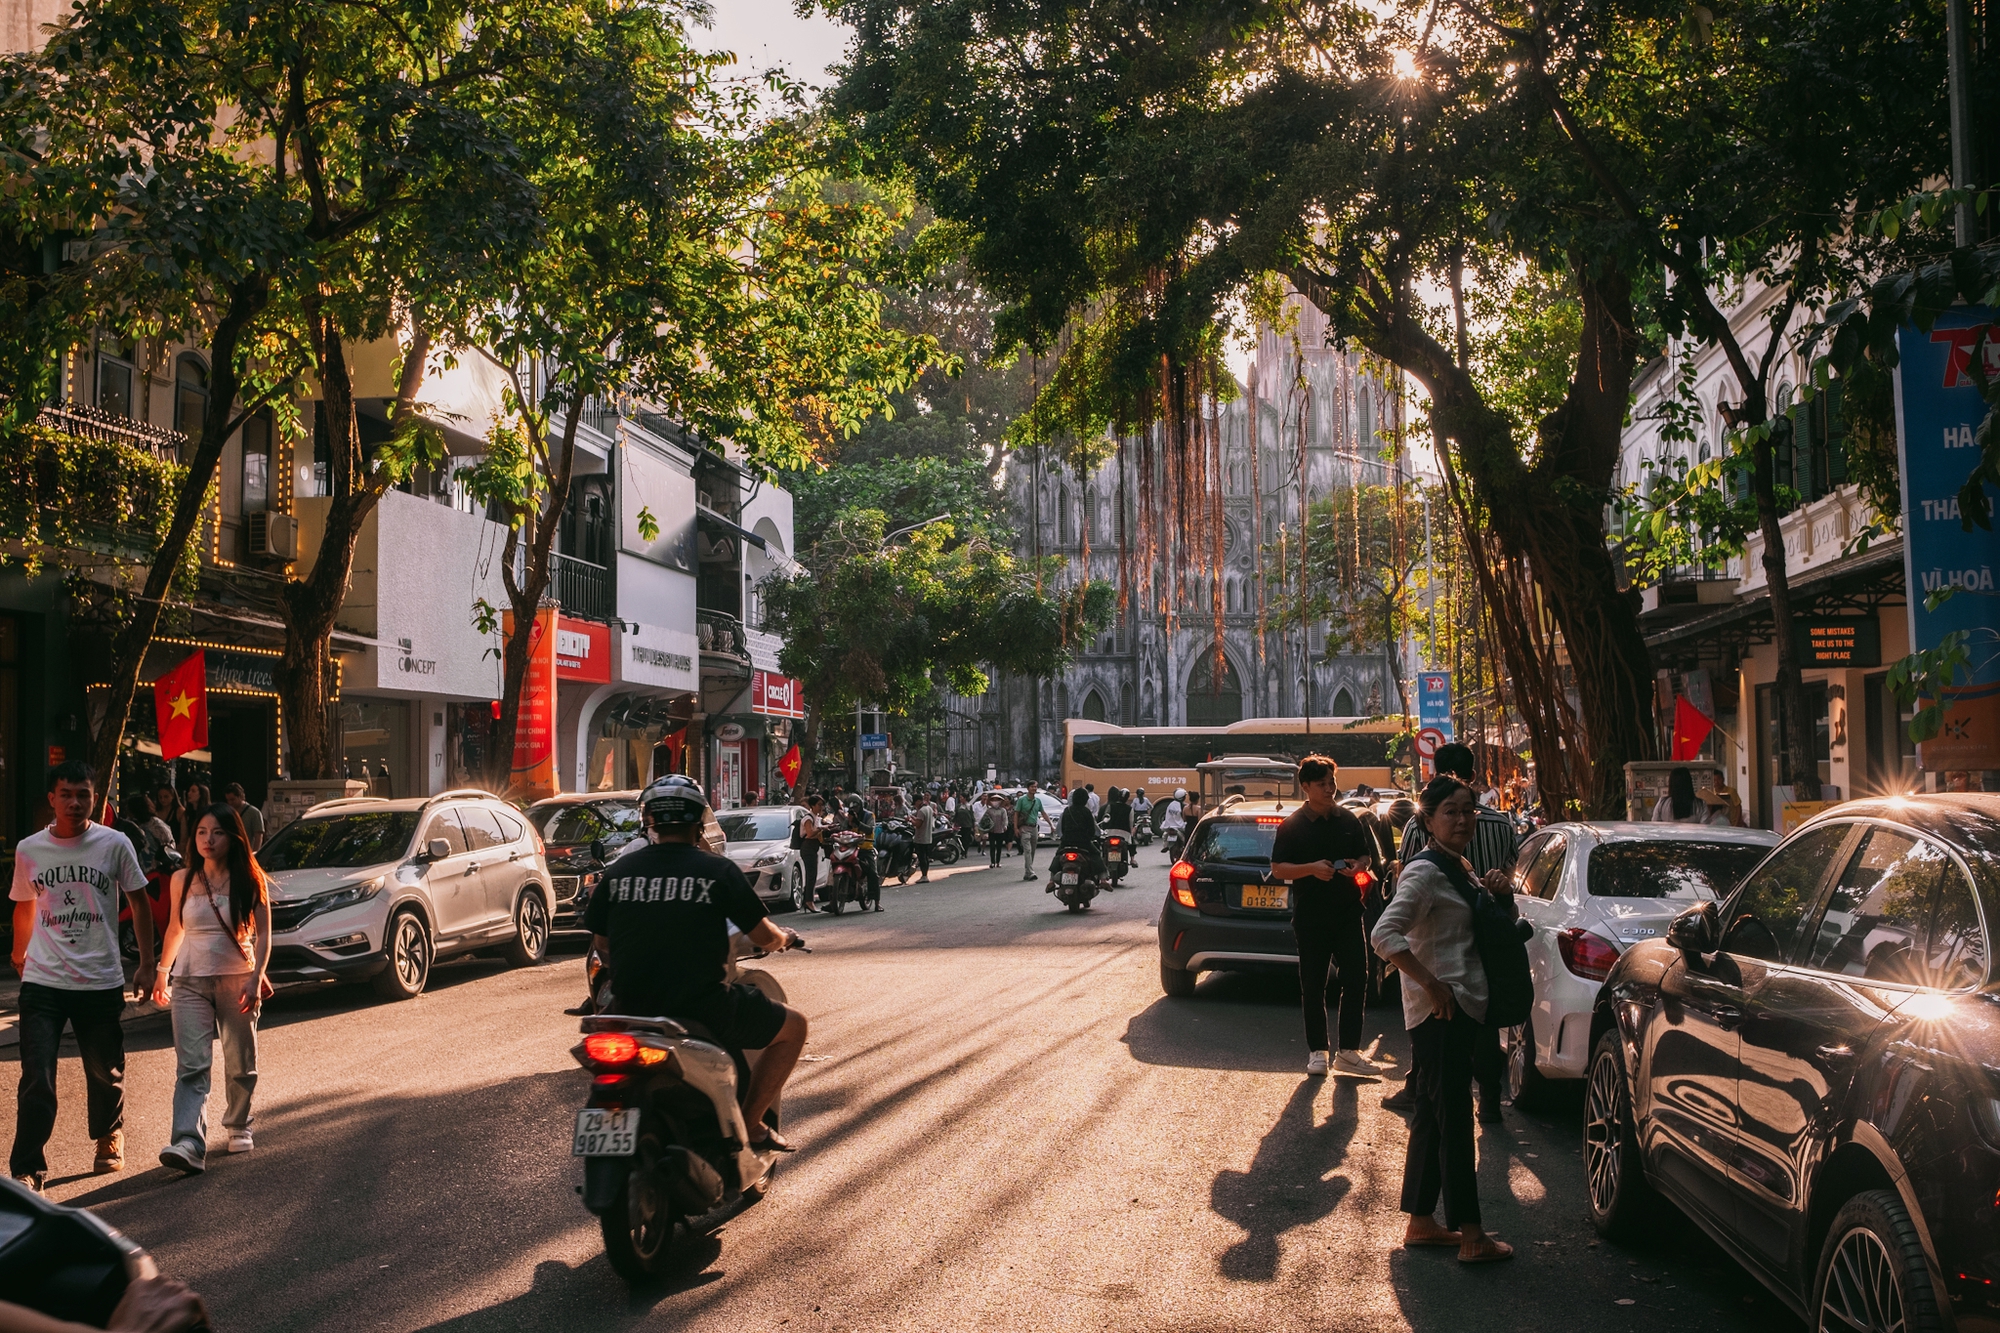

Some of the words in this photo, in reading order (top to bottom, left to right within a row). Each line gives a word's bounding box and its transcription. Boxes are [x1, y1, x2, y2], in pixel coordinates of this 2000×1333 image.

[1943, 422, 1974, 448] HÀ
[1948, 564, 1994, 590] HOÀ
[1810, 628, 1826, 636] SOME
[1827, 627, 1855, 635] MISTAKES
[1811, 640, 1826, 648] TAKE
[1844, 639, 1854, 647] THE
[1815, 652, 1832, 660] RIGHT
[1833, 651, 1851, 659] PLACE
[398, 656, 436, 675] CONCEPT
[214, 661, 244, 688] three
[247, 668, 273, 687] trees
[768, 684, 783, 700] CIRCLE
[435, 753, 442, 767] 17
[63, 889, 76, 906] &
[608, 876, 717, 904] PARADOX
[1258, 886, 1276, 896] 17H
[1246, 896, 1283, 908] 018.25
[1631, 927, 1655, 935] 300
[584, 1111, 629, 1132] 29-C1
[576, 1133, 632, 1153] 987.55
